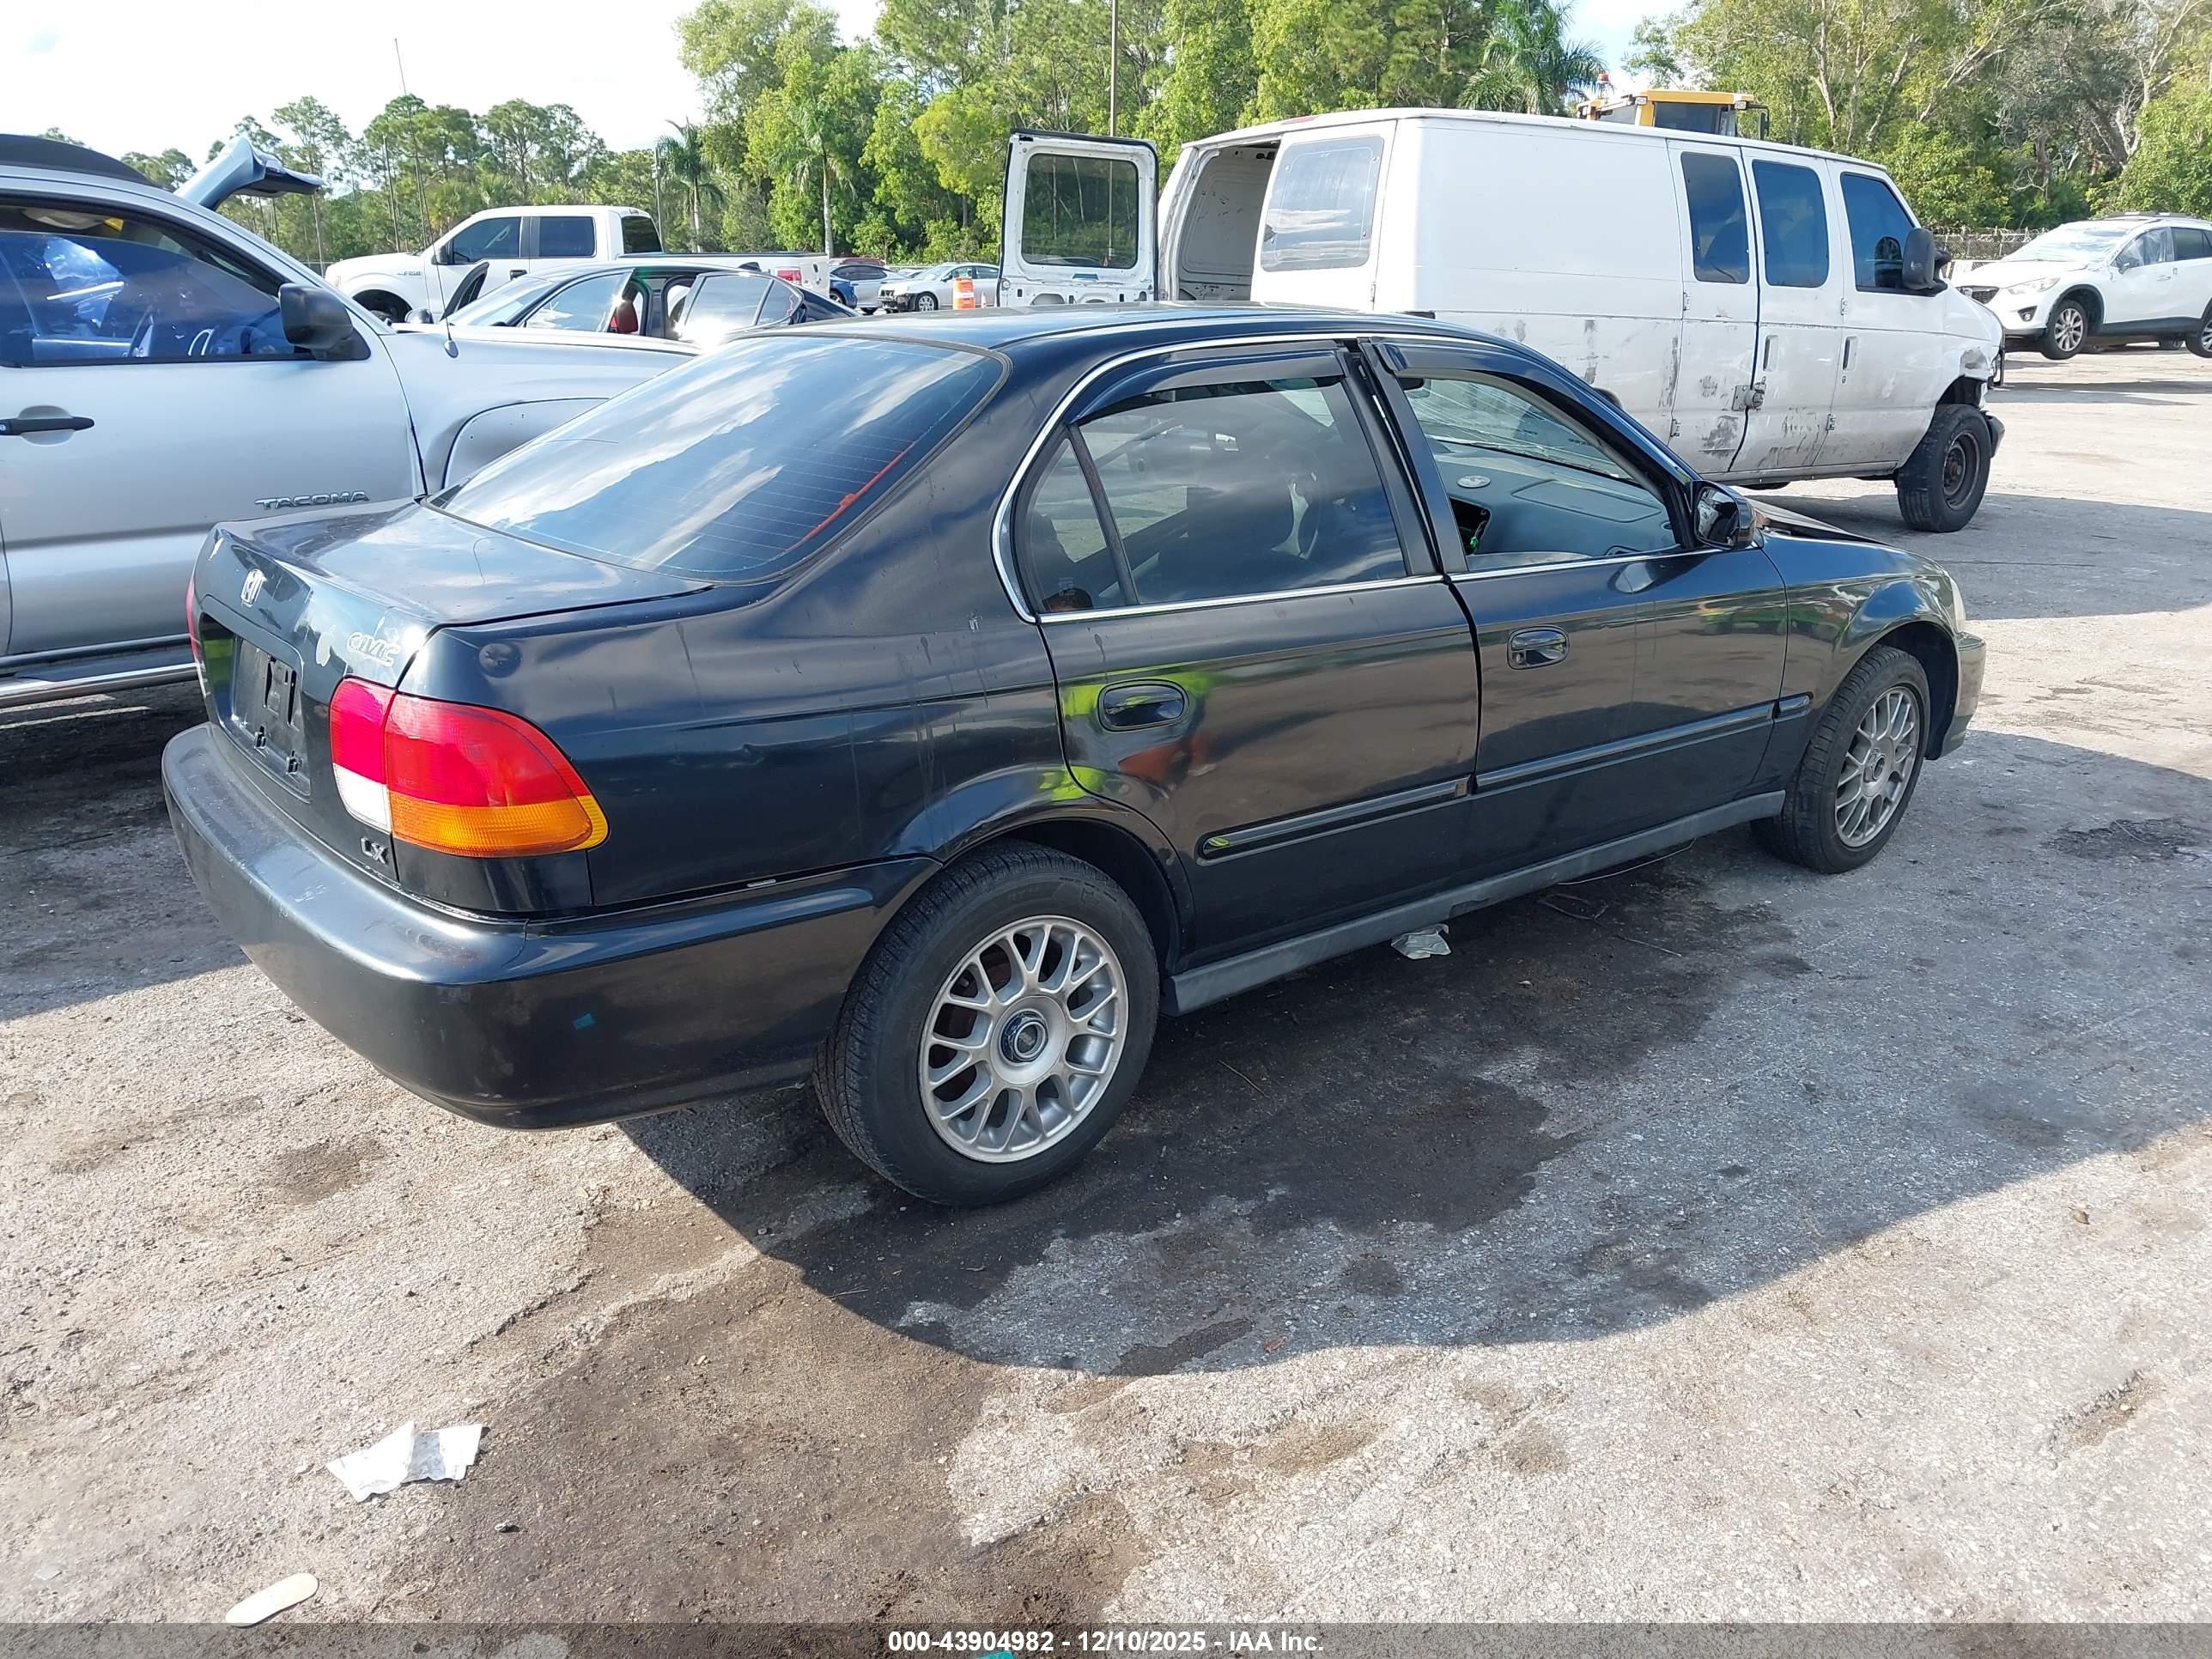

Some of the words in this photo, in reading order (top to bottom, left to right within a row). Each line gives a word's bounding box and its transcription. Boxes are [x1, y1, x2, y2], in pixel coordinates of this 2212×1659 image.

[254, 490, 370, 510] TACOMA
[347, 632, 401, 667] CIVIC
[361, 836, 388, 866] LX
